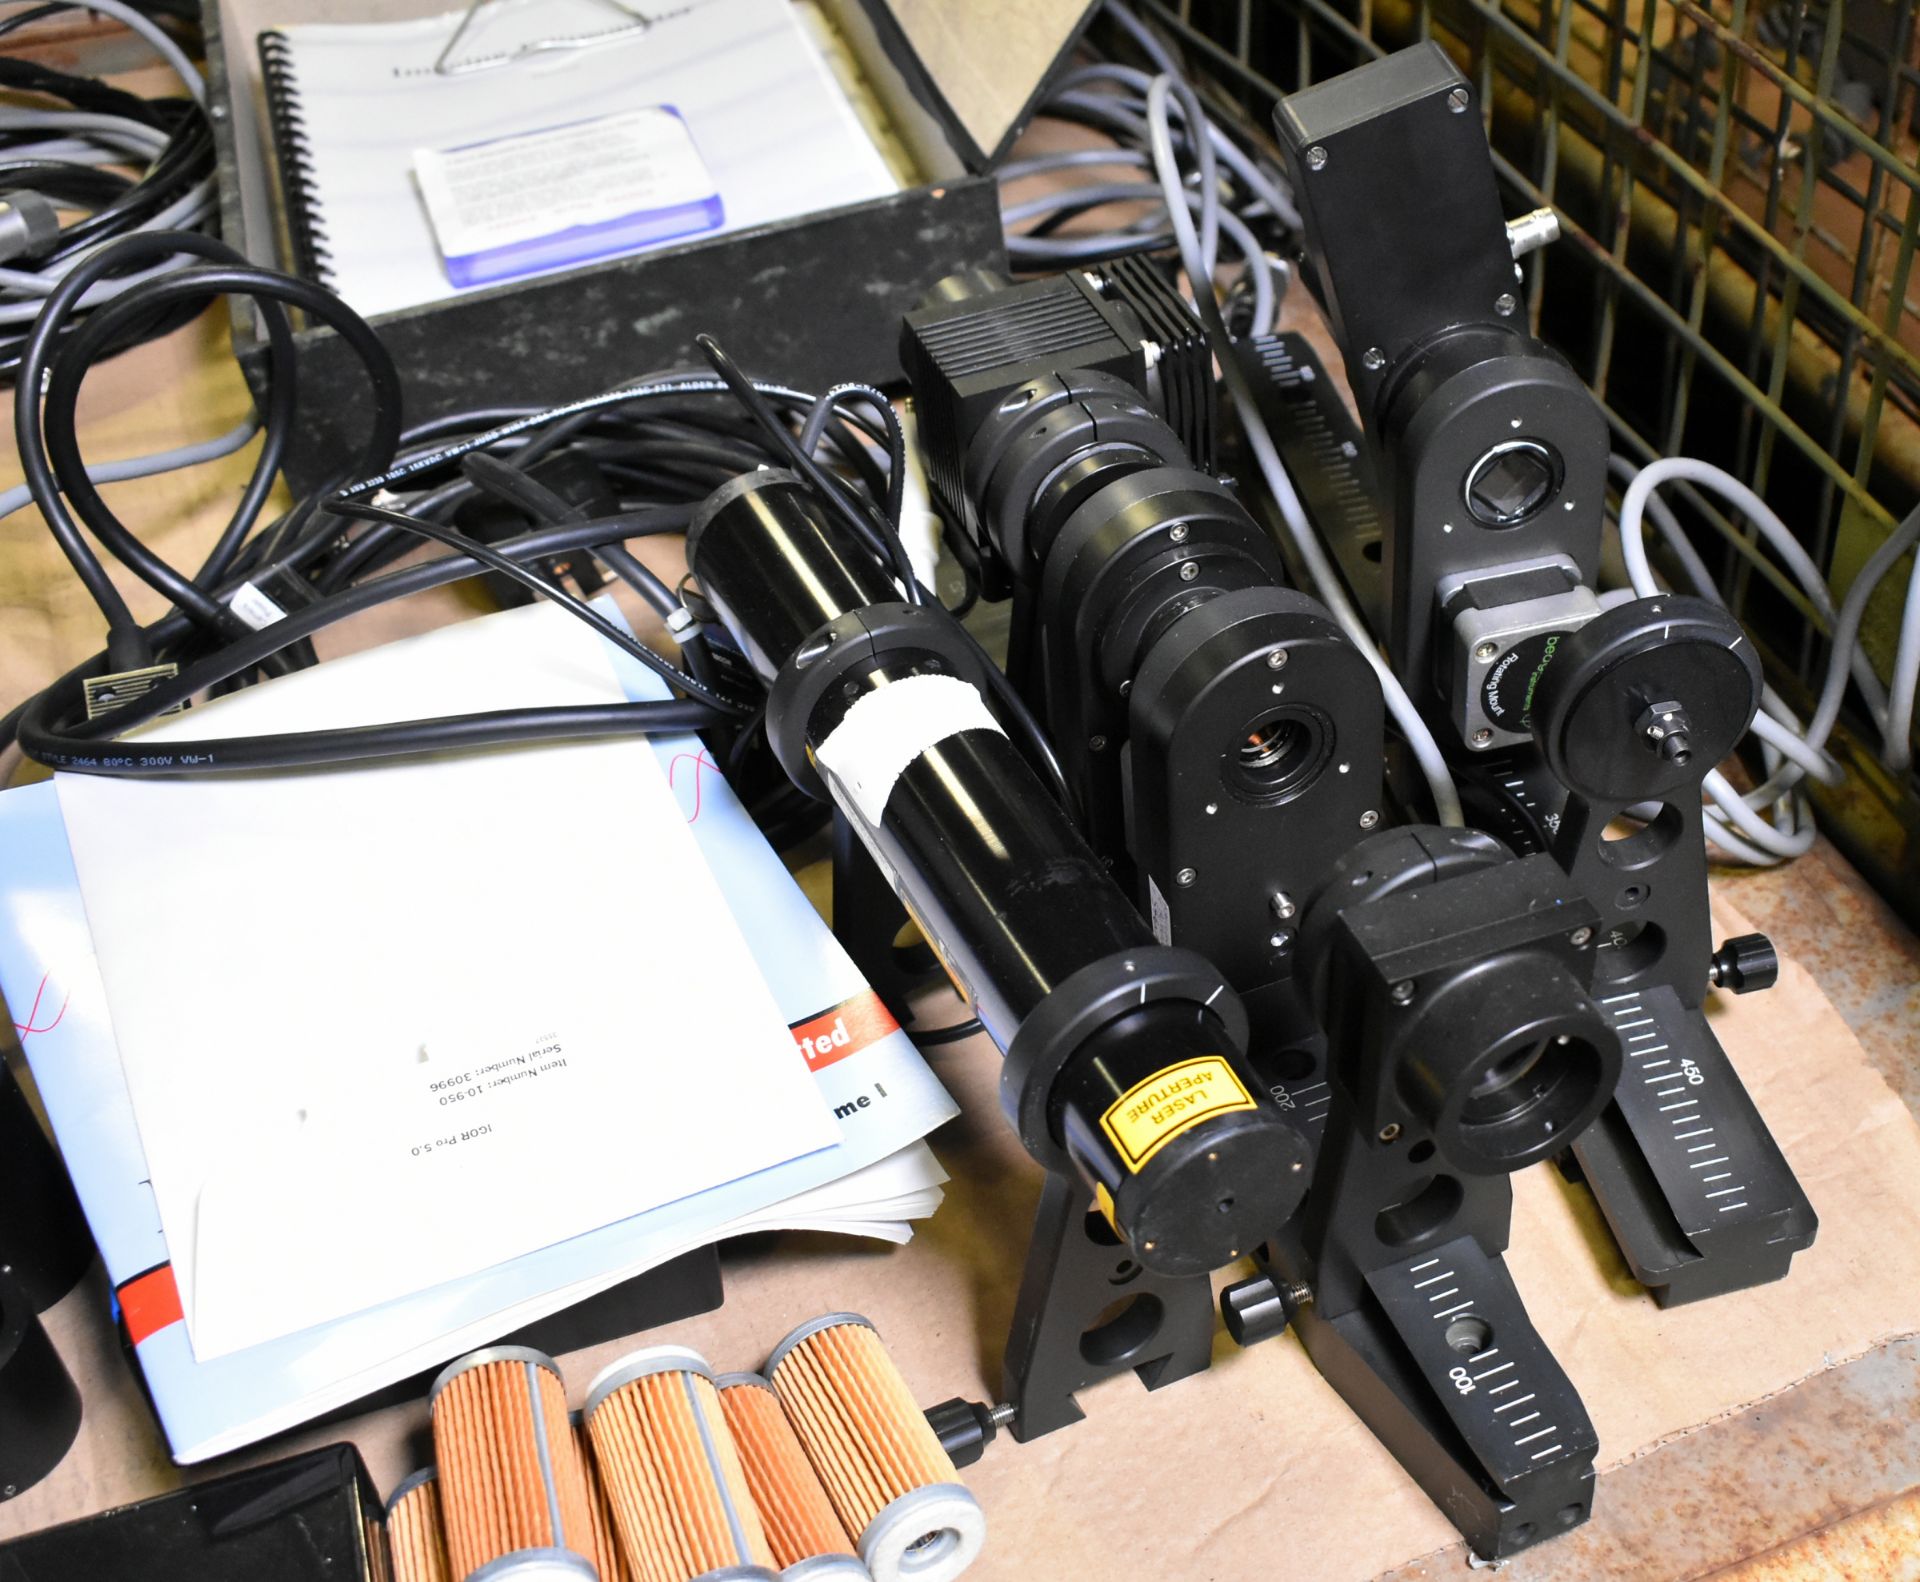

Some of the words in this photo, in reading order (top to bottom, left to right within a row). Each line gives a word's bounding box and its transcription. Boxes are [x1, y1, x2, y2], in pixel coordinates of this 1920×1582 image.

[1486, 652, 1519, 690] Rotating
[1487, 690, 1505, 717] Mount
[140, 756, 173, 767] 300V
[180, 753, 214, 765] VW-1
[797, 1016, 851, 1060] ted
[529, 1043, 562, 1061] Serial
[475, 1055, 526, 1076] Number:
[540, 1058, 568, 1072] Item
[1680, 1058, 1705, 1086] 450
[430, 1072, 472, 1092] 30996
[488, 1068, 538, 1088] Number:
[439, 1085, 483, 1106] 10-950
[1126, 1071, 1214, 1124] APERTURE
[1269, 1085, 1296, 1112] 200
[1152, 1089, 1209, 1125] LASER
[436, 1136, 457, 1147] Pro
[461, 1124, 492, 1142] IGOR
[411, 1143, 432, 1157] 5.0
[1449, 1366, 1476, 1395] 100
